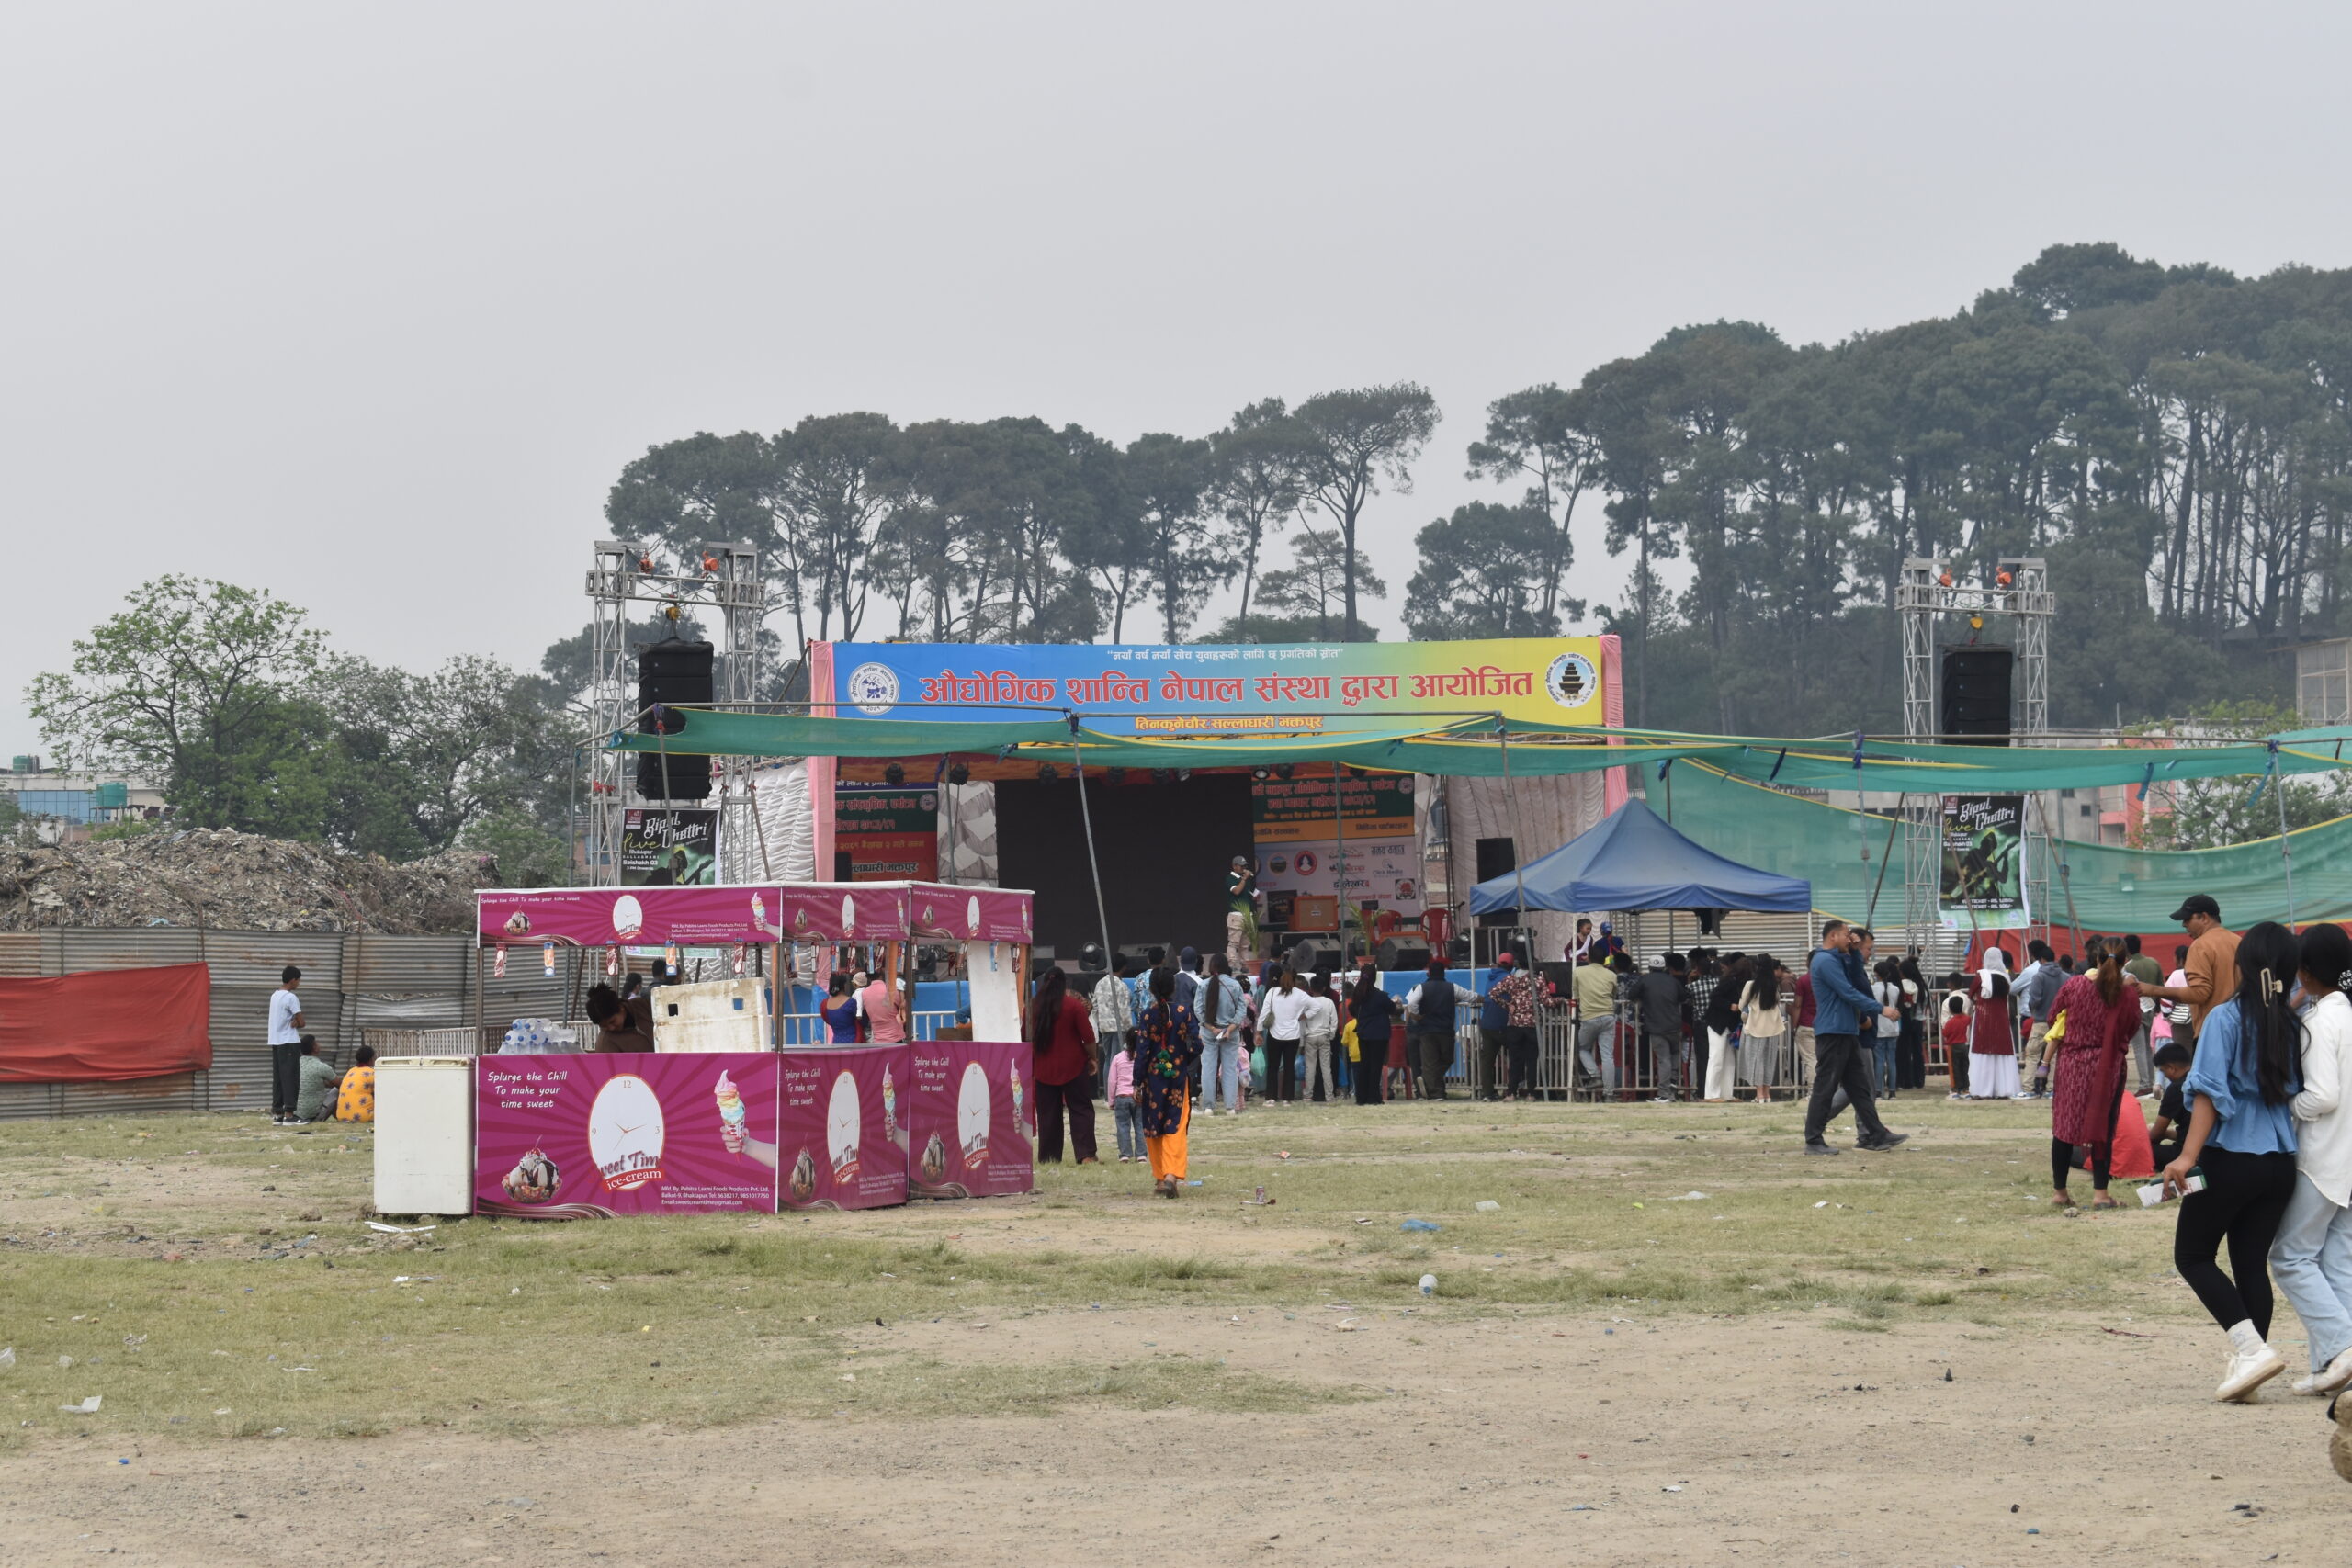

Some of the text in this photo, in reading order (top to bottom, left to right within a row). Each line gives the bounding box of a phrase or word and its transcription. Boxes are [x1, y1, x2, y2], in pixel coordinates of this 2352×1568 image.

[1135, 649, 1149, 660] वर्ष
[1151, 649, 1170, 660] नयाँ
[1173, 649, 1193, 660] सोच
[1243, 649, 1264, 659] लागि
[920, 669, 1057, 704] औद्योगिक
[1065, 670, 1151, 705] शान्ति
[1159, 670, 1244, 704] नेपाल
[1254, 671, 1330, 702] संस्था
[1340, 675, 1399, 707] द्वारा
[1409, 665, 1533, 698] आयोजित
[488, 1071, 568, 1083] Splurge the Chill
[785, 1069, 800, 1081] Splurge
[811, 1067, 820, 1077] Chill
[623, 1080, 631, 1089] 12
[787, 1083, 817, 1094] To make your
[495, 1085, 561, 1097] To make your
[501, 1100, 554, 1108] time sweet
[790, 1096, 813, 1106] time sweet
[655, 1126, 661, 1134] 3
[628, 1150, 661, 1169] Tim
[606, 1170, 662, 1190] ice-cream
